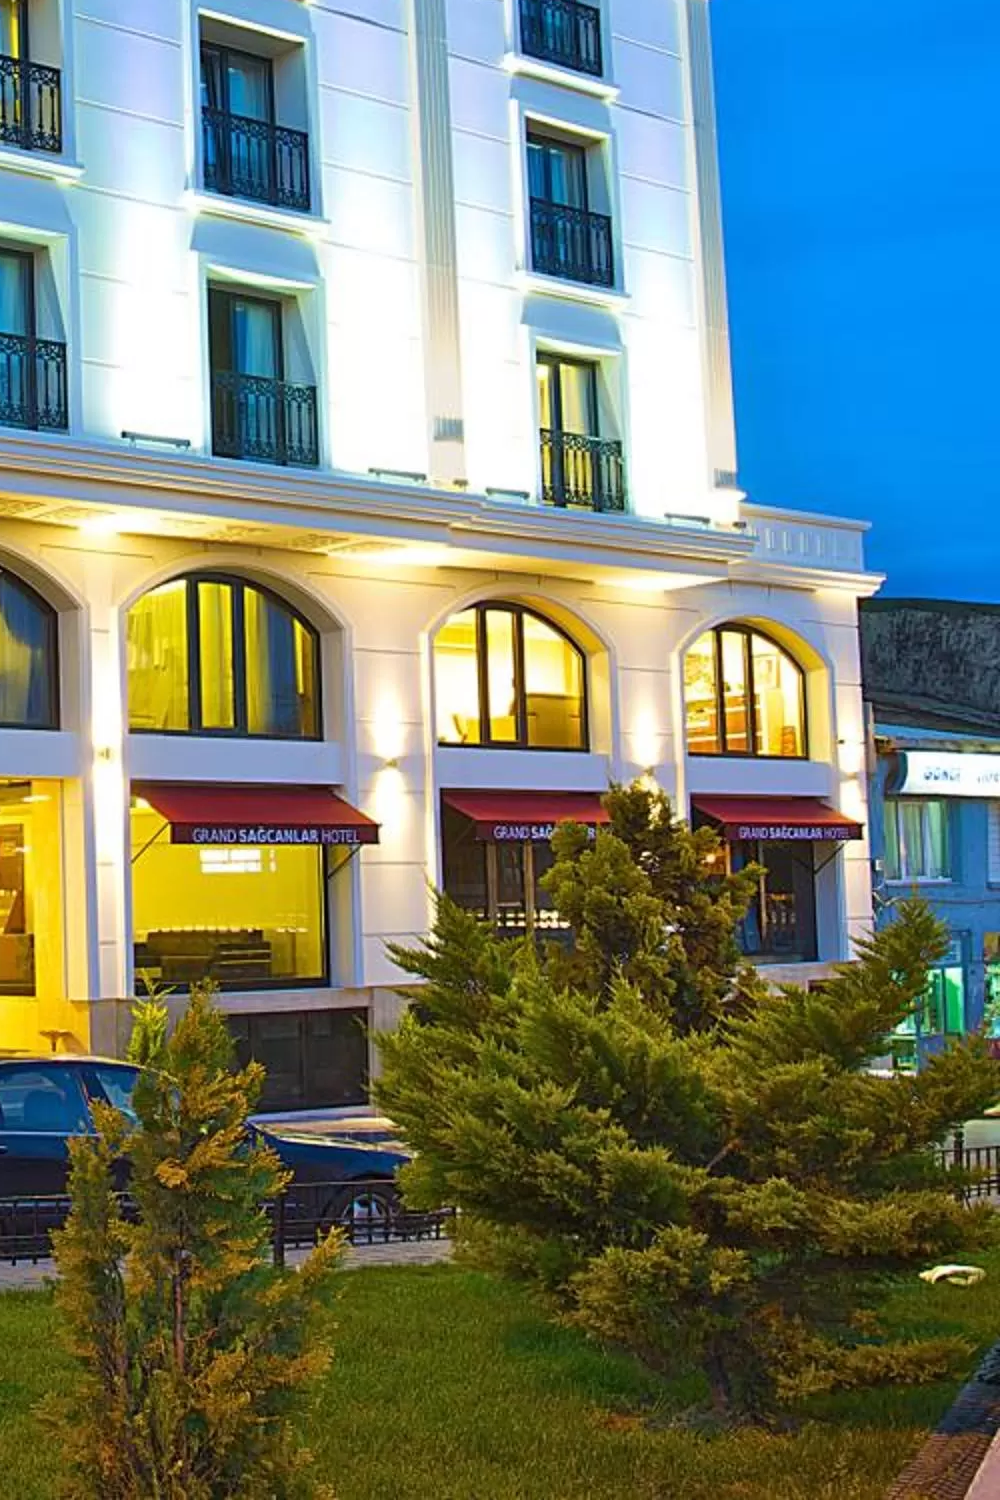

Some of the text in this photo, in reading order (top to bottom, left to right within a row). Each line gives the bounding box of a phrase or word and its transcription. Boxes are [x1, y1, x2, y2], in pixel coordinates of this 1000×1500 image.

[192, 825, 360, 843] GRAND SAĞCANLAR HOTEL
[493, 825, 529, 839] GRAND
[738, 826, 768, 839] GRAND
